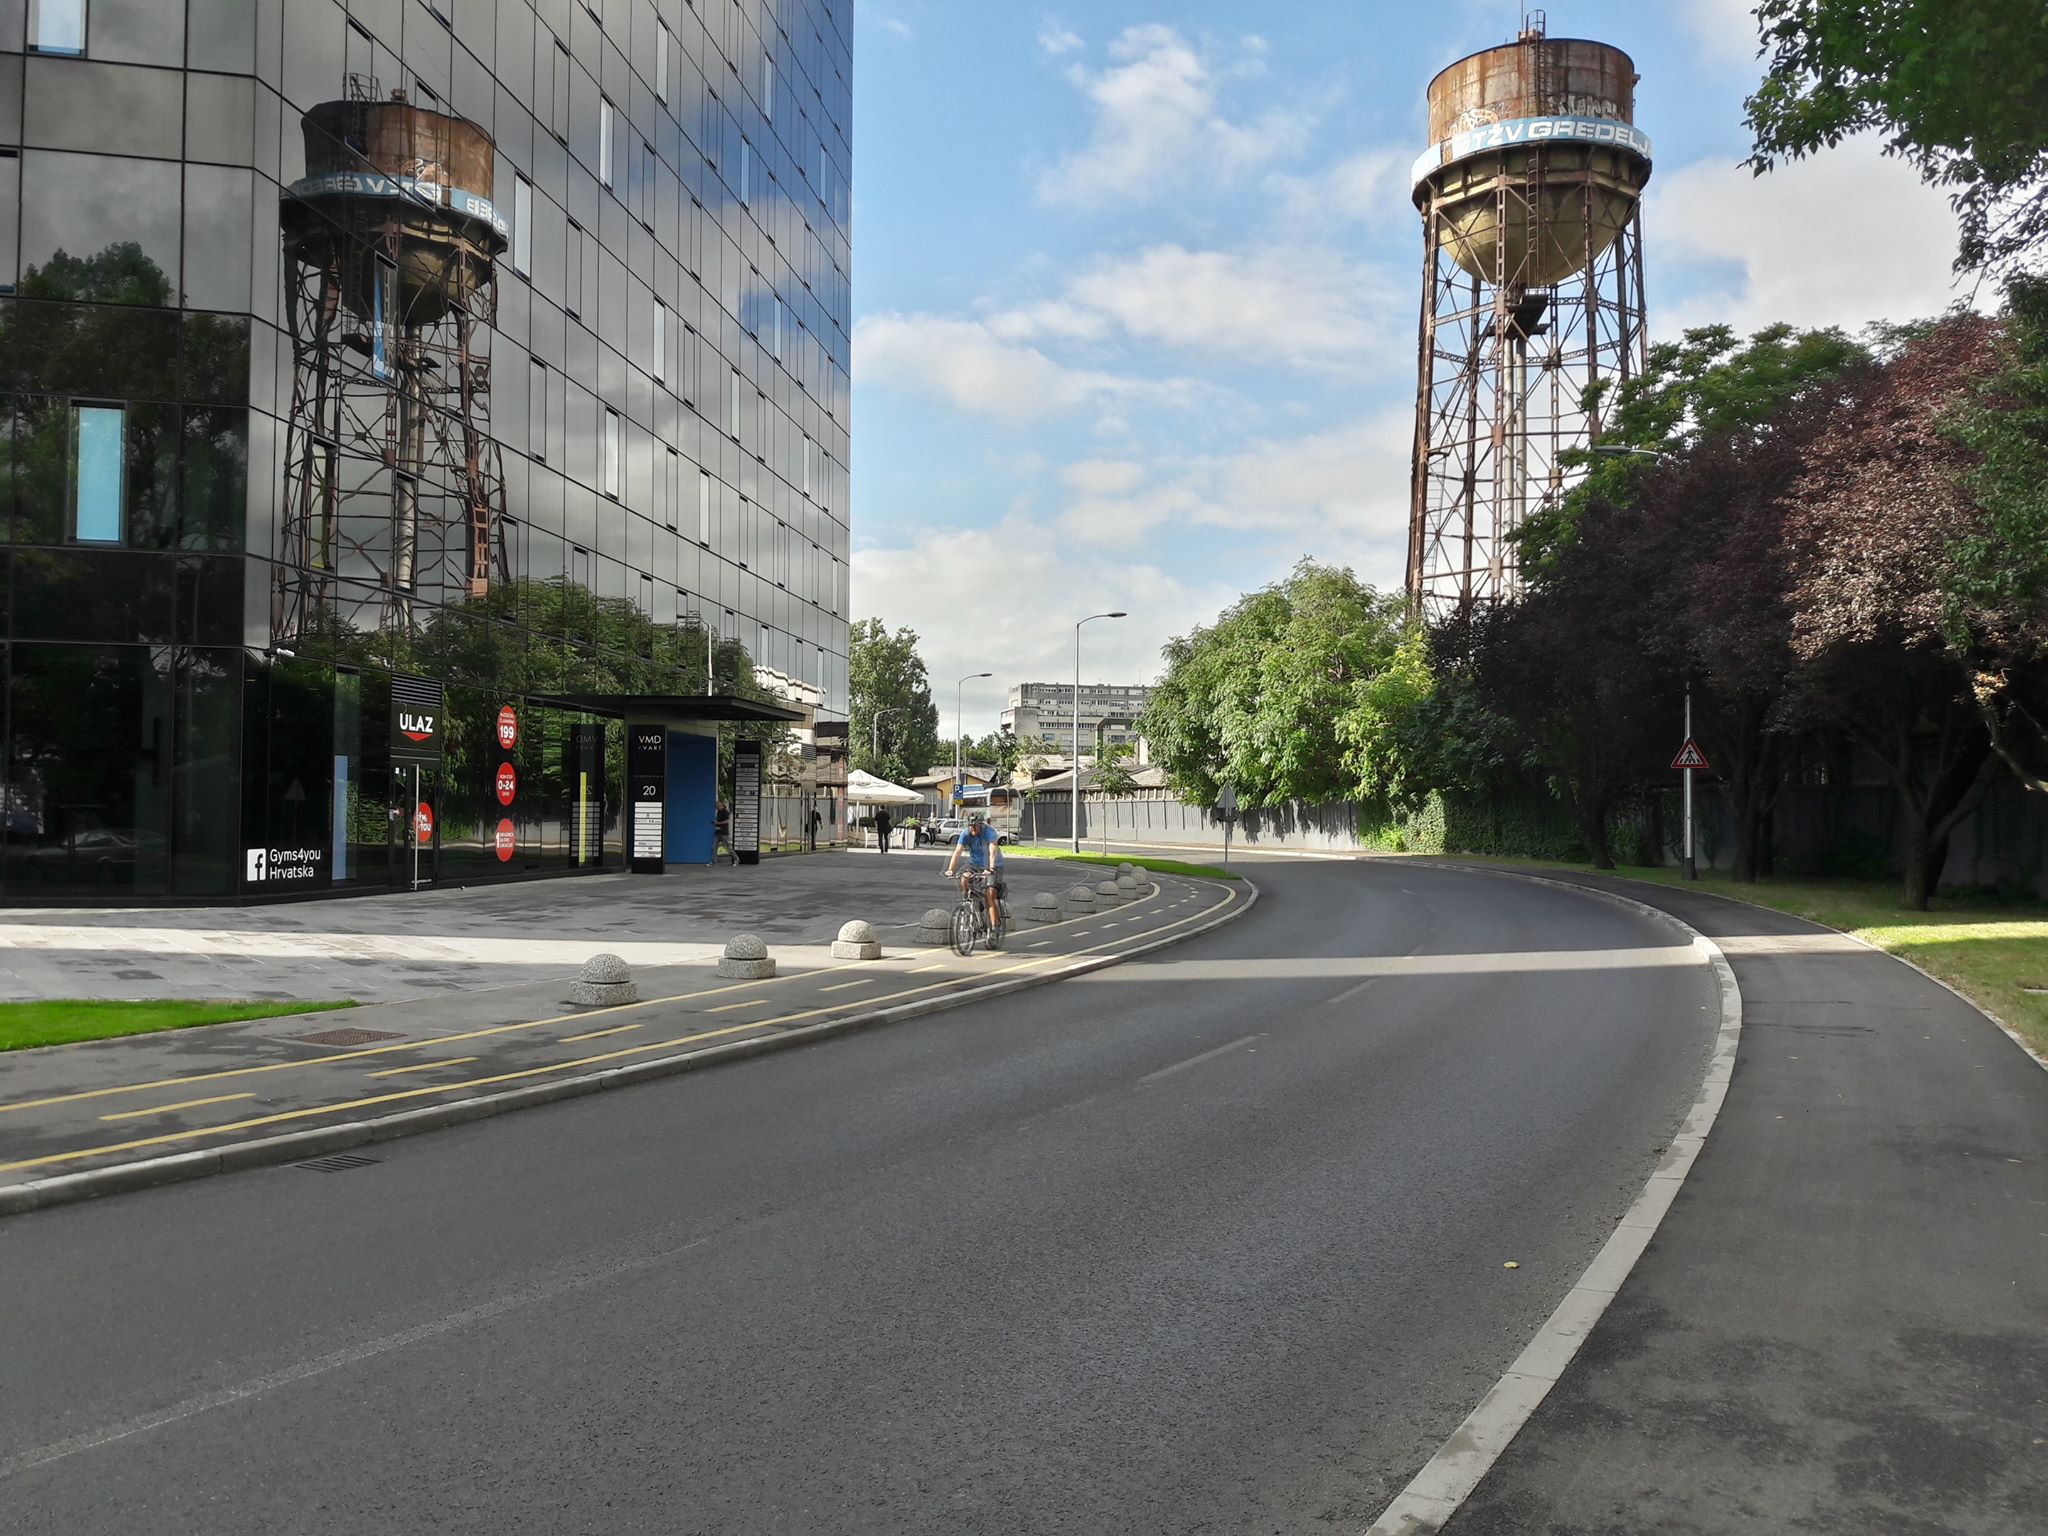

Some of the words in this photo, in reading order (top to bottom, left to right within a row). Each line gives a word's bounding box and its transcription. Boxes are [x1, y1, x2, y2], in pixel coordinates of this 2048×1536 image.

[399, 713, 433, 733] ULAZ
[500, 725, 514, 739] 199
[638, 735, 662, 744] VMD
[498, 780, 514, 790] 0-24
[643, 785, 656, 796] 20
[270, 848, 321, 865] Gyms4you
[270, 864, 314, 880] Hrvatska
